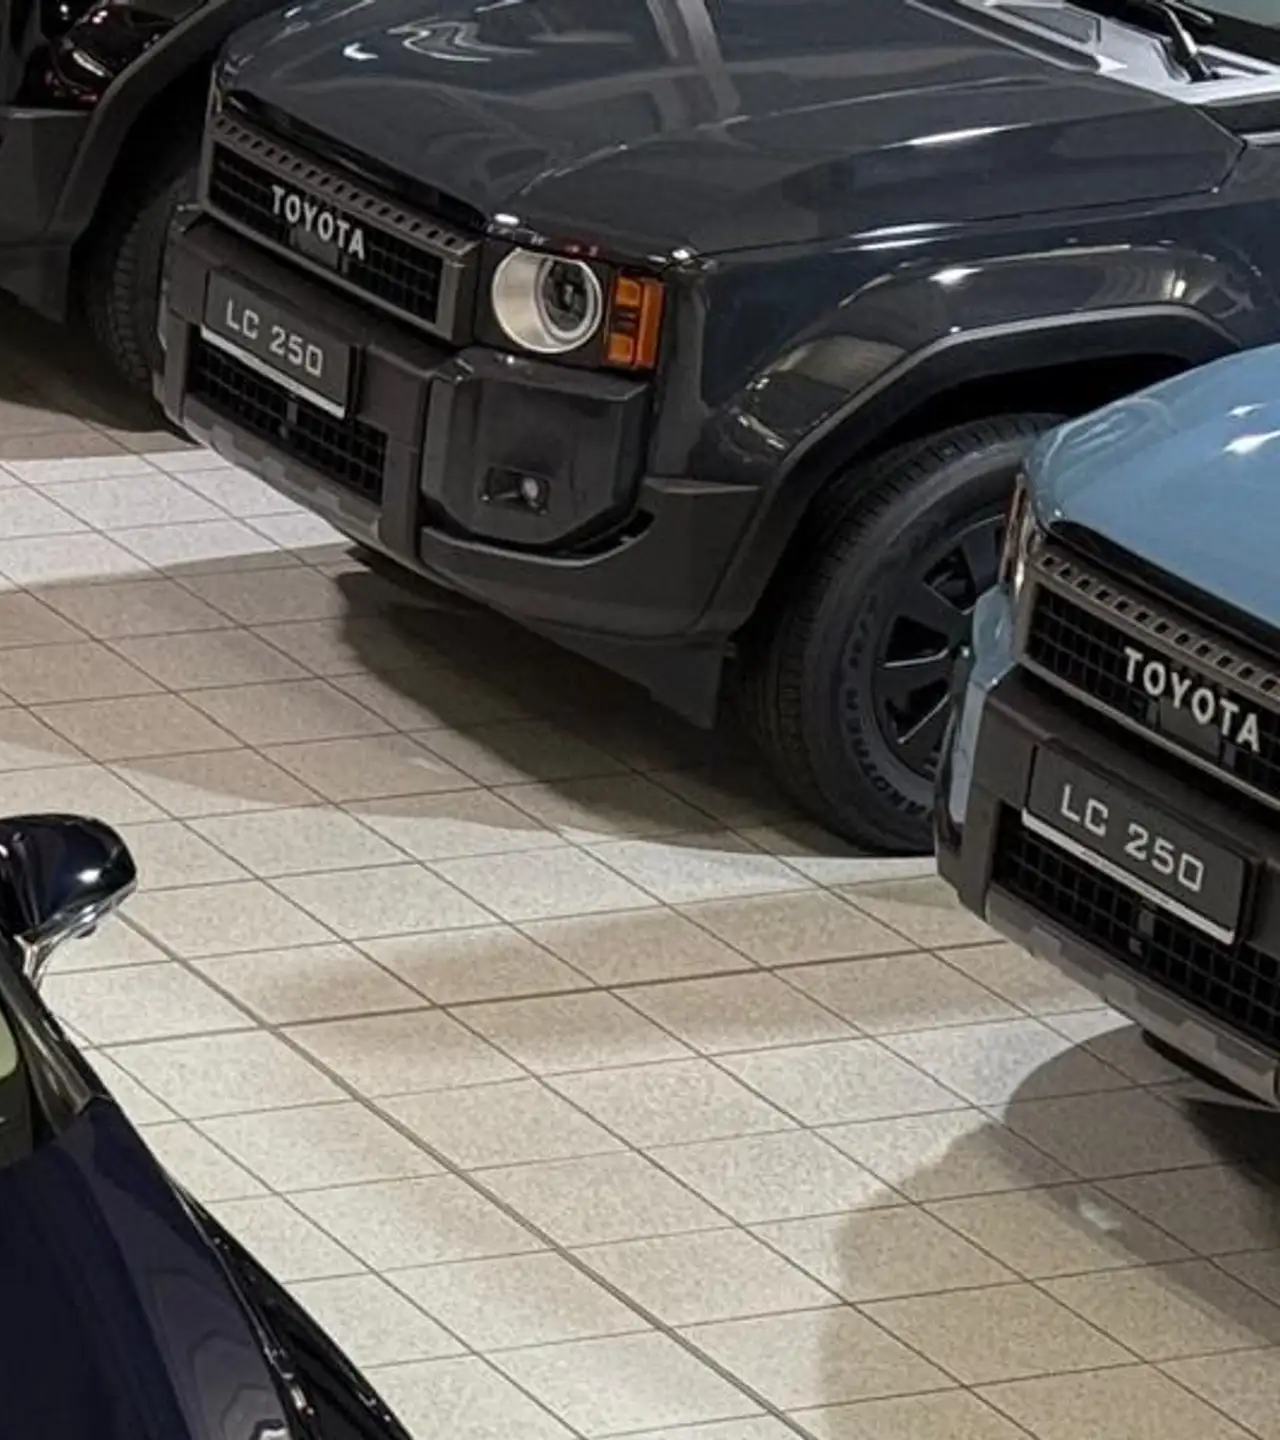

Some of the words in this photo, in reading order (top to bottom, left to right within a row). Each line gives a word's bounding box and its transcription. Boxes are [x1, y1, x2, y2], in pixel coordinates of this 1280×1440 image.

[271, 184, 366, 261] TOYOTA
[226, 298, 260, 340] LC
[269, 325, 324, 378] 250
[1123, 646, 1260, 753] TOYOTA
[1060, 783, 1109, 837] LC
[1123, 822, 1205, 893] 250
